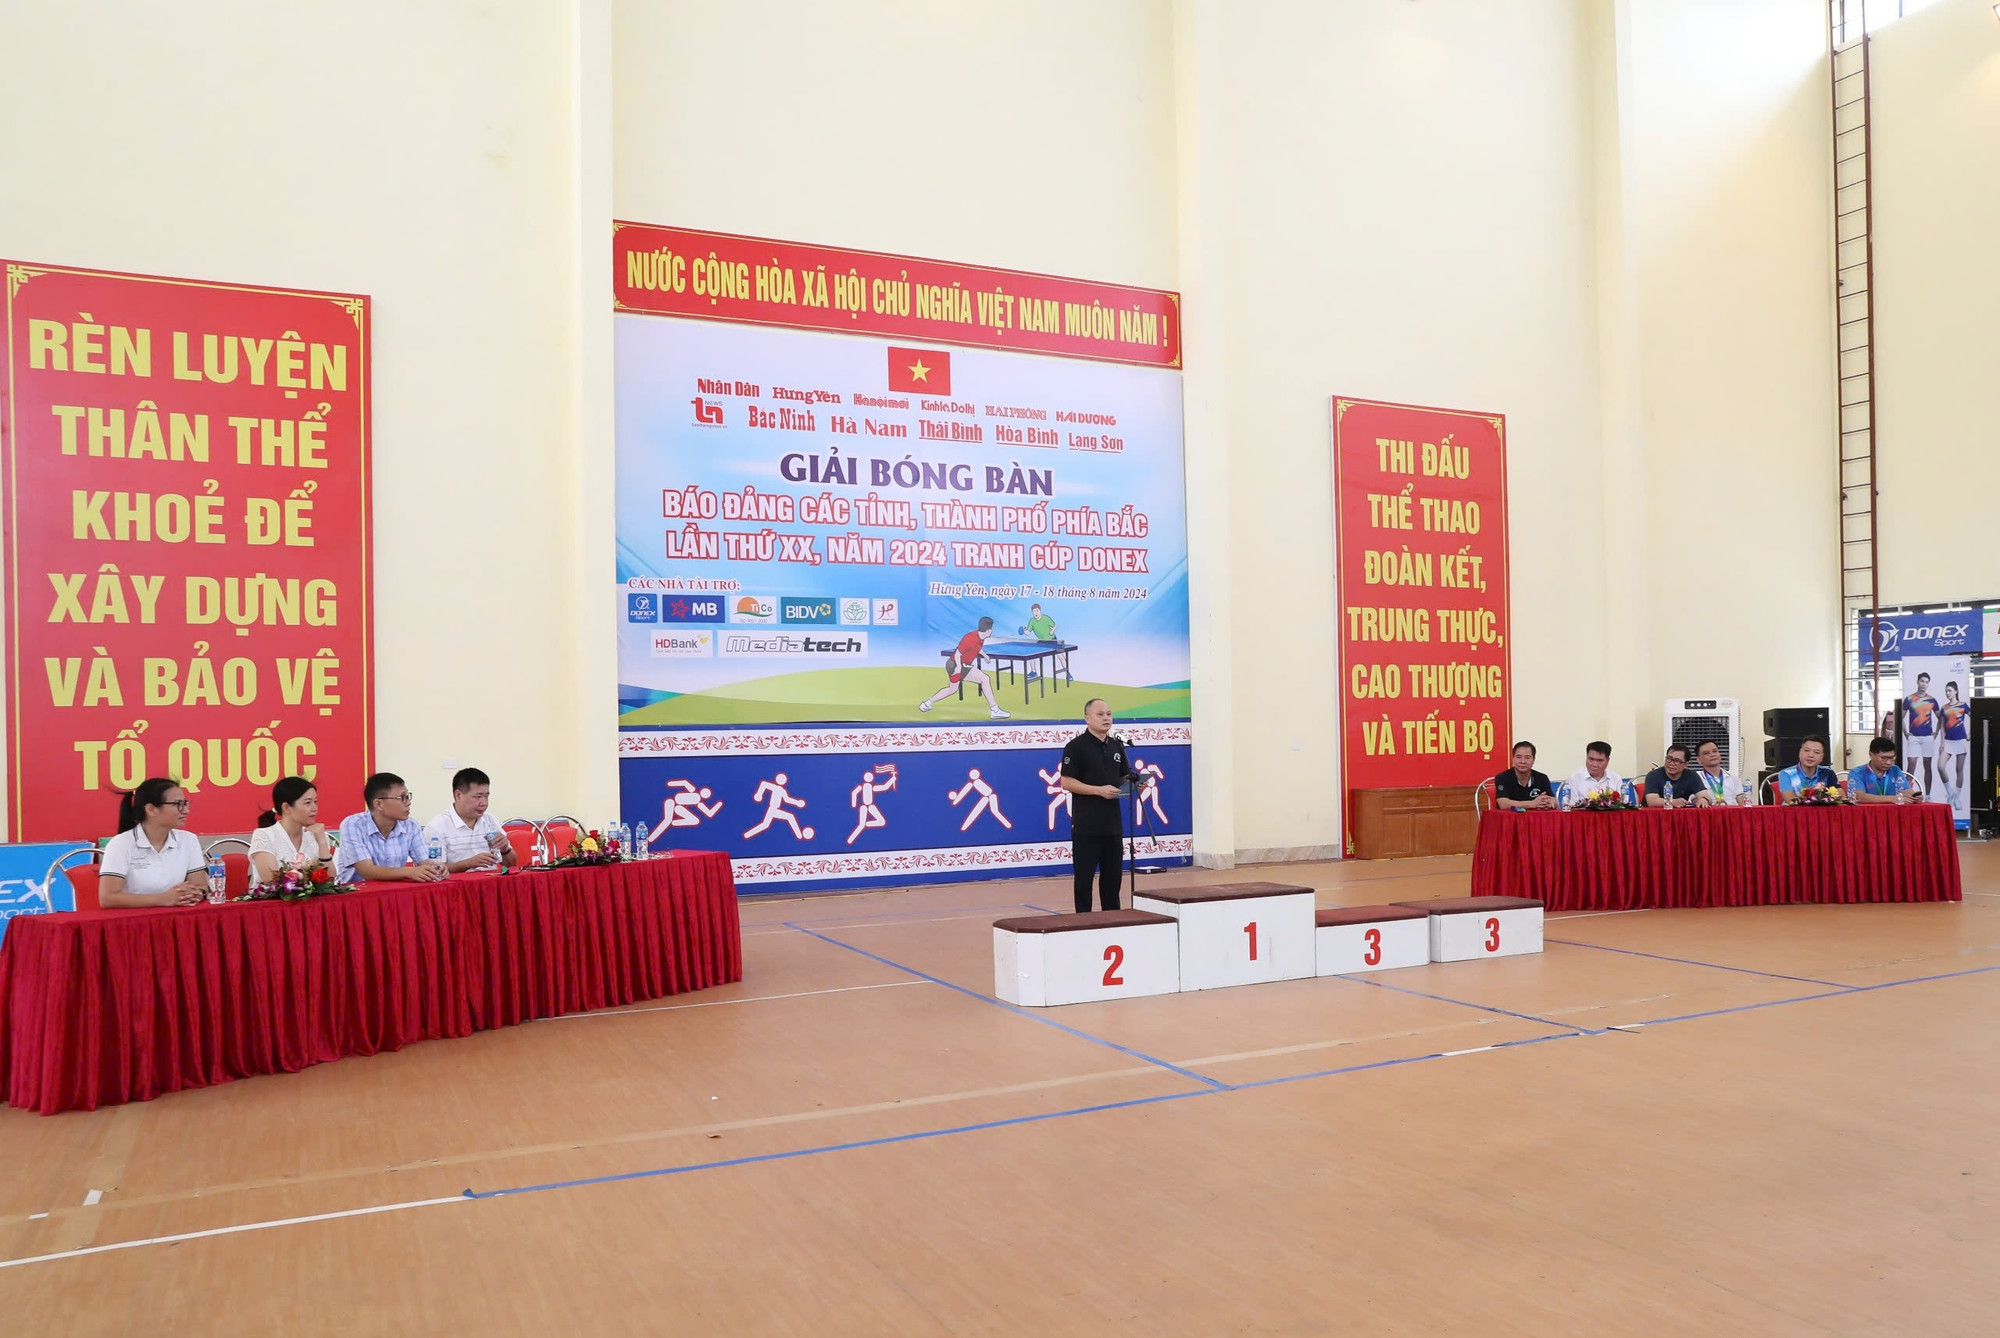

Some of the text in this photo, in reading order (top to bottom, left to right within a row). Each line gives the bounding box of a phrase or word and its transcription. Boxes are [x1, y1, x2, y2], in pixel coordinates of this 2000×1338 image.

[627, 246, 685, 293] NƯỚC
[692, 252, 749, 305] CỘNG
[756, 257, 796, 305] HÒA
[802, 265, 829, 308] XÃ
[834, 268, 867, 319] HỘI
[872, 270, 910, 317] CHỦ
[916, 281, 972, 324] NGHĨA
[977, 287, 1014, 335] VIỆT
[1019, 297, 1059, 334] NAM
[1065, 299, 1115, 341] MUÔN
[1120, 305, 1157, 346] NĂM
[29, 312, 347, 399] RÈN LUYỆN
[697, 378, 760, 397] Nhân Dân
[51, 400, 331, 469] THÂN THỂ
[779, 408, 815, 431] Ninh
[831, 416, 907, 437] Hà Nam
[919, 419, 983, 441] Thái Bình
[995, 424, 1059, 445] Hòa Bình
[1069, 433, 1124, 451] Lạng Sơn
[1376, 434, 1470, 480] THI ĐẤU
[780, 446, 1053, 496] GIẢI BÓNG BÀN
[71, 478, 318, 547] KHOẺ ĐỂ
[663, 485, 1149, 538] BÁO ĐẢNG CÁC TỈNH, THÀNH PHỐ PHÍA BẮC
[1367, 483, 1481, 535] THỂ THAO
[666, 522, 1149, 573] LẦN THỨ XX, NĂM 2024 TRANH CÚP DONEX
[628, 577, 741, 592] CÁC NHÀ TÀI TRỢ:
[1364, 545, 1487, 593] ĐOÀN KẾT,
[47, 563, 337, 637] XÂY DỰNG
[692, 602, 718, 616] MB
[929, 582, 962, 598] Hưng
[965, 583, 988, 597] Yên,
[991, 585, 1017, 598] ngày
[1019, 585, 1032, 597] 17
[1043, 586, 1054, 597] 18
[1057, 588, 1087, 600] tháng
[1089, 588, 1096, 598] 8
[1099, 589, 1120, 599] năm
[1123, 588, 1147, 600] 2024
[786, 605, 819, 619] BIDV
[1347, 606, 1503, 650] TRUNG THỰC,
[655, 639, 698, 649] HDBank
[726, 636, 862, 653] Mediatech
[1903, 624, 1969, 640] DONEX
[1934, 639, 1964, 647] Sport
[44, 640, 341, 716] VÀ BẢO VỆ
[1351, 662, 1502, 706] CAO THƯỢNG
[1362, 710, 1495, 760] VÀ TIẾN BỘ
[74, 719, 318, 794] TỔ QUỐC
[1244, 922, 1257, 960] 1
[1364, 928, 1381, 966] 3
[1485, 917, 1500, 952] 3
[1102, 945, 1124, 986] 2
